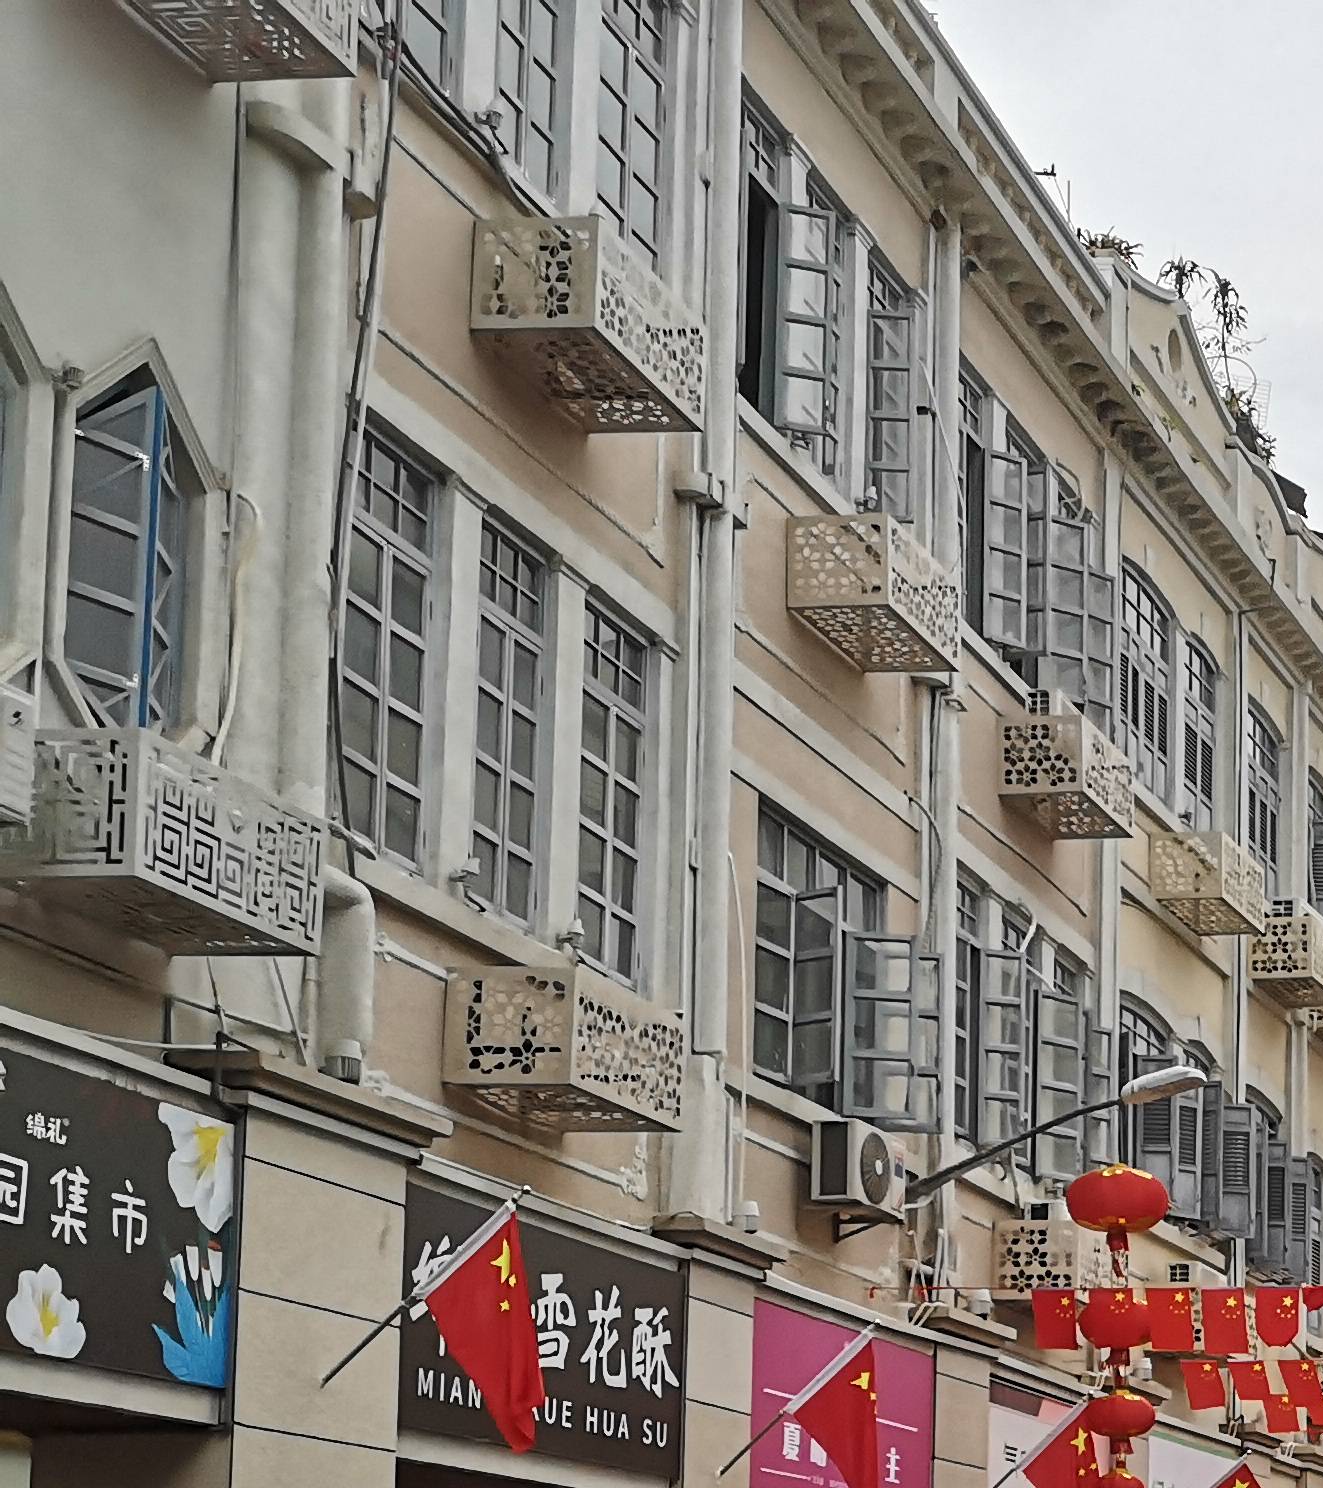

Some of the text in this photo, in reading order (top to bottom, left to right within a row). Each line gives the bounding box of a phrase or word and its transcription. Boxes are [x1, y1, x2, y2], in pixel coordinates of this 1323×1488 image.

[26, 1112, 68, 1145] 绵礼
[409, 1235, 680, 1399] 雪花酥
[416, 1367, 669, 1448] MIAN UE HUA SU
